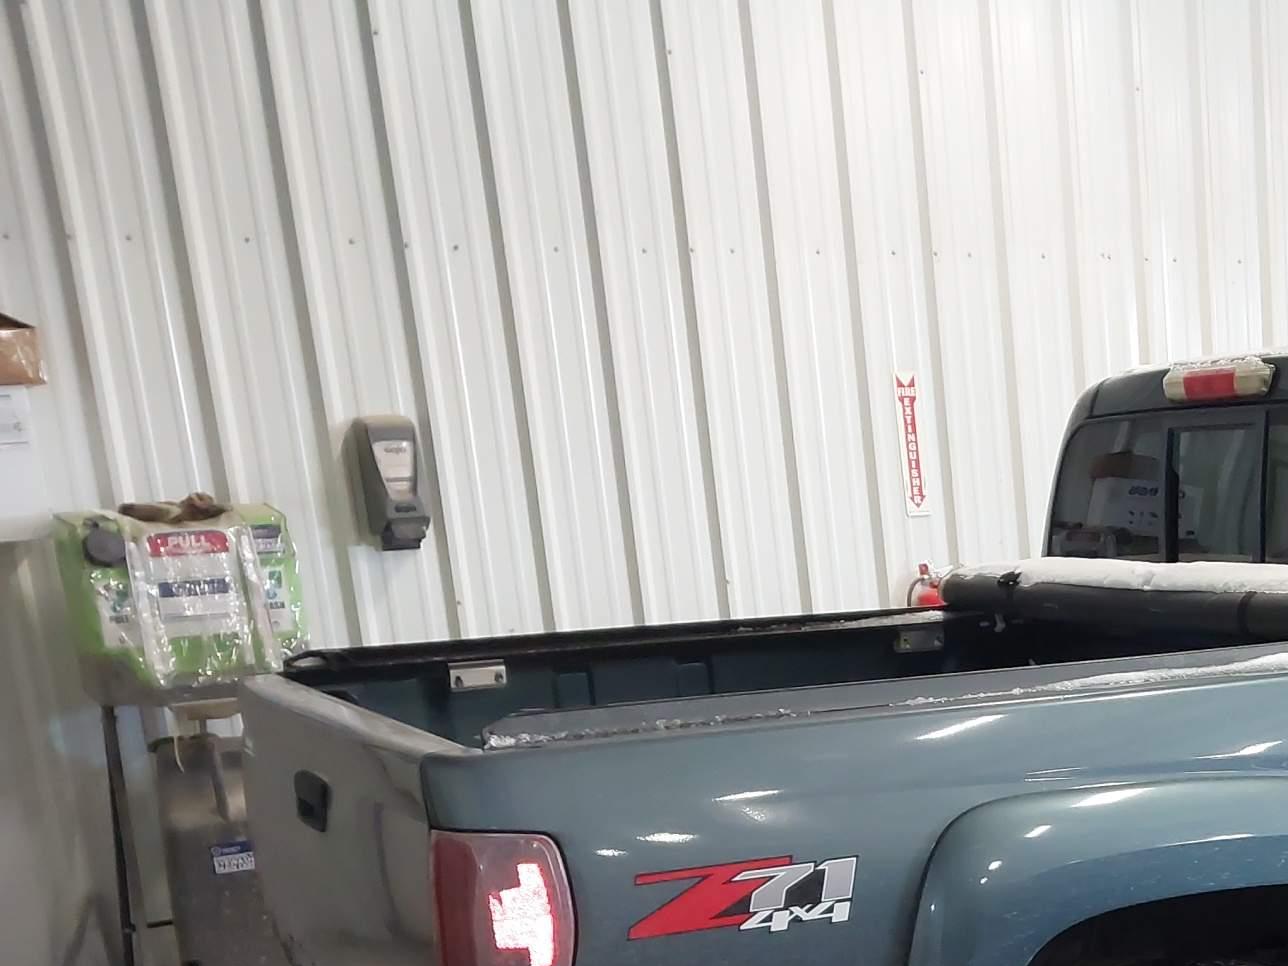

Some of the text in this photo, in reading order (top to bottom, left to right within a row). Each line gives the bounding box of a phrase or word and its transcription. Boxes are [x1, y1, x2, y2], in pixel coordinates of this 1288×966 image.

[898, 387, 917, 396] FIRE
[903, 398, 923, 504] EXTINGUISHER
[167, 534, 211, 548] PULL
[628, 855, 858, 940] Z71
